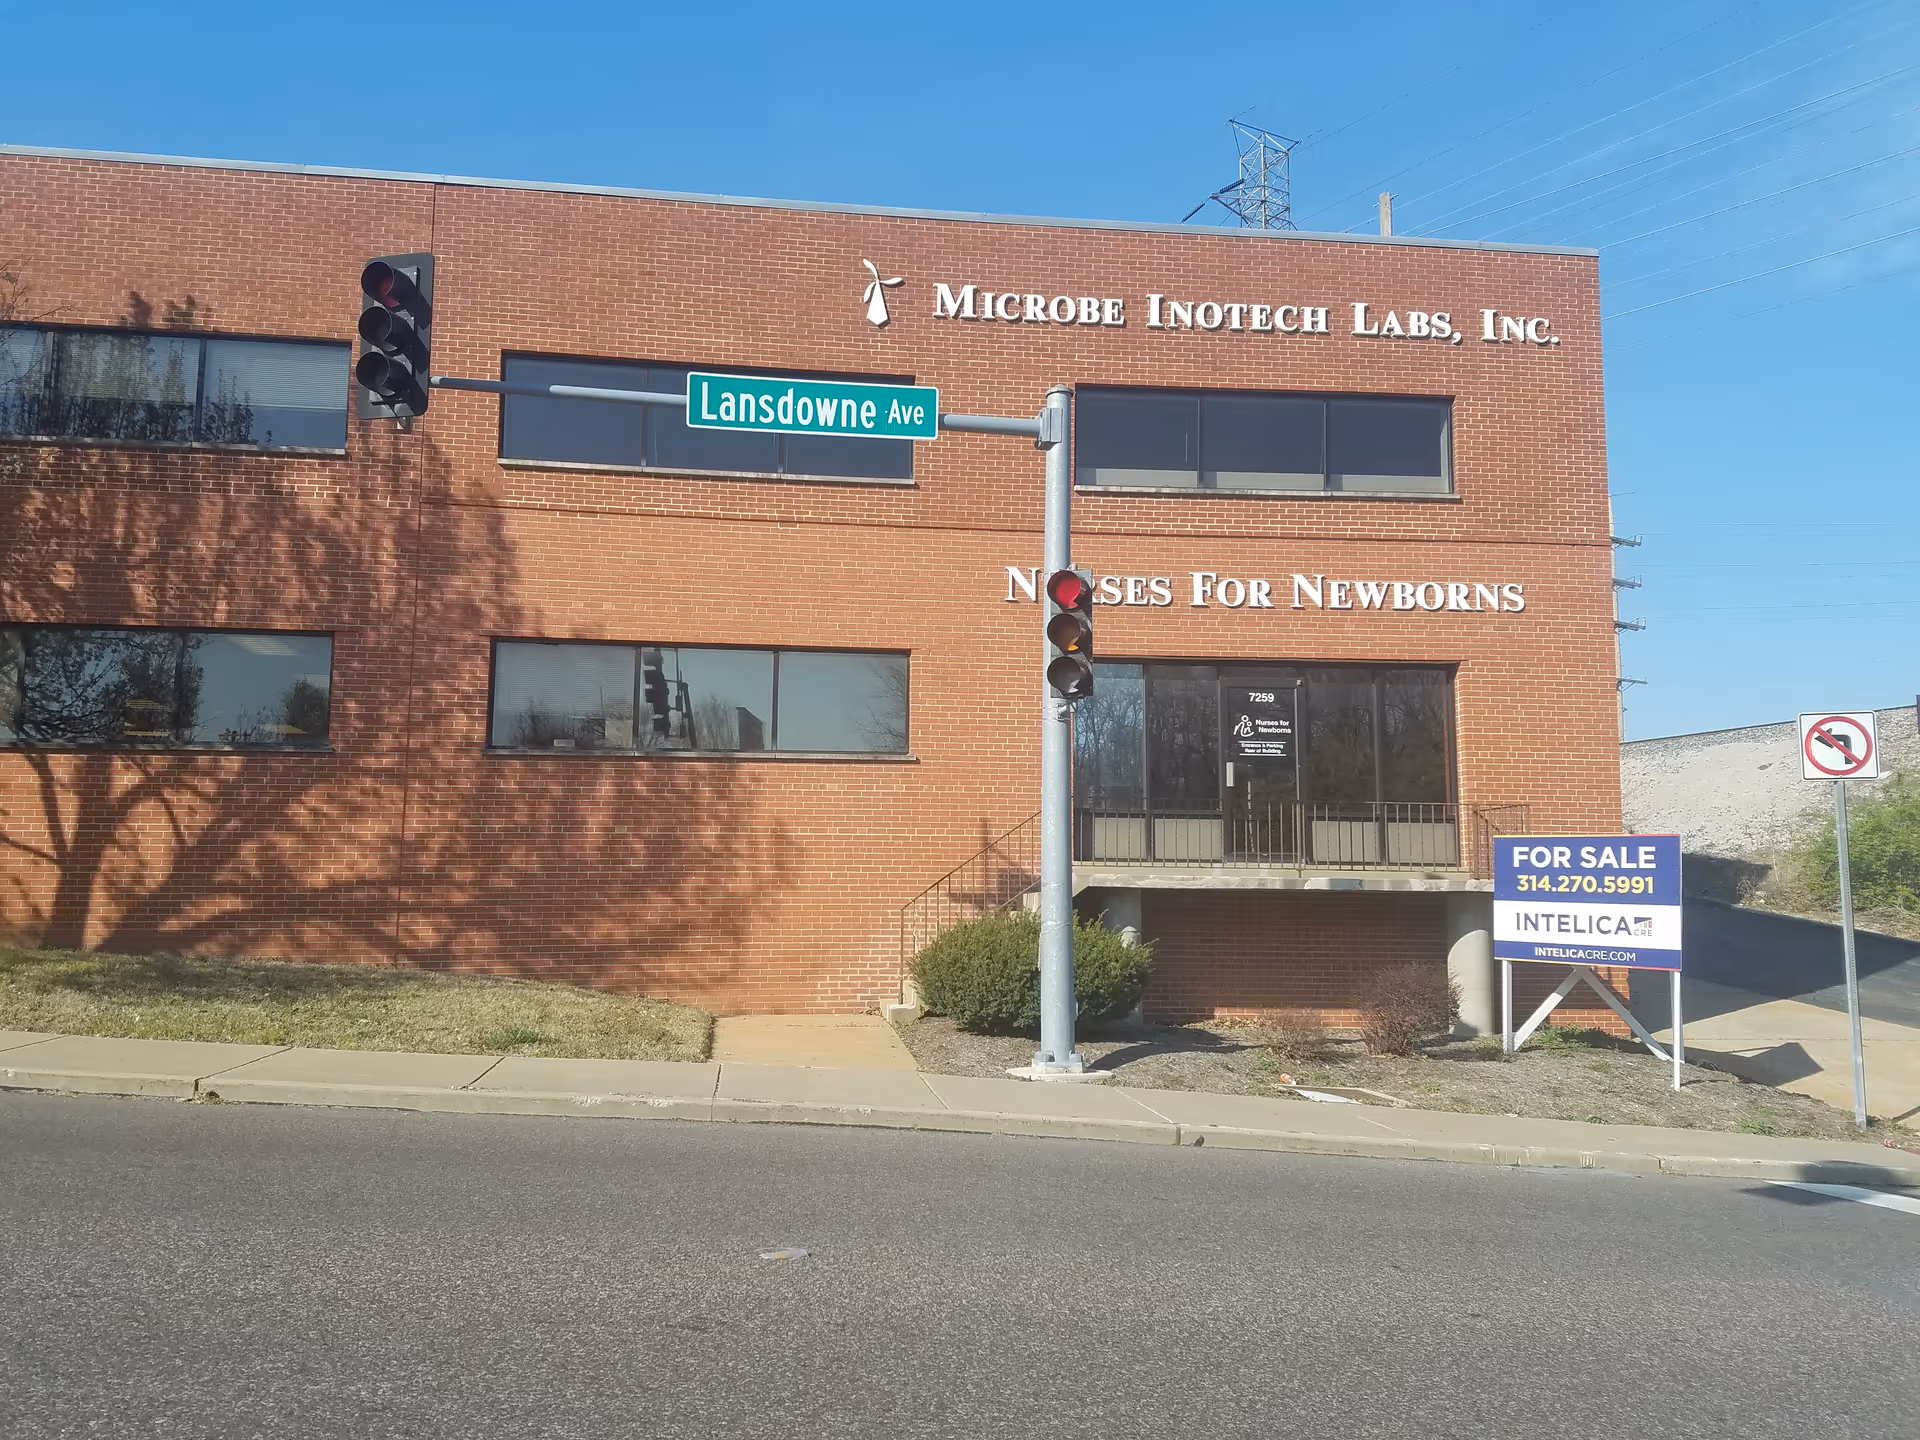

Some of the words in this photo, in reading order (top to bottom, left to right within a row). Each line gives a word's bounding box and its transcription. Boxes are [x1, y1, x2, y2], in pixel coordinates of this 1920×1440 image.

[933, 282, 1125, 326] MICROBE
[1145, 292, 1329, 334] INOTECH
[1351, 301, 1462, 345] LABS,
[1479, 308, 1560, 346] INC.
[701, 381, 877, 429] Lansdowne
[887, 399, 925, 426] Ave
[1004, 566, 1174, 606] NSES
[1189, 571, 1275, 610] FOR
[1290, 573, 1526, 613] NEWBORNS
[1248, 692, 1275, 703] 7259
[1258, 726, 1292, 734] Newborns
[1513, 846, 1571, 868] FOR
[1580, 846, 1657, 869] SALE
[1516, 874, 1654, 894] 314.270.5991
[1516, 912, 1632, 936] INTELICA
[1634, 929, 1653, 937] CRE
[1534, 946, 1636, 962] INTELICACRE.COM
